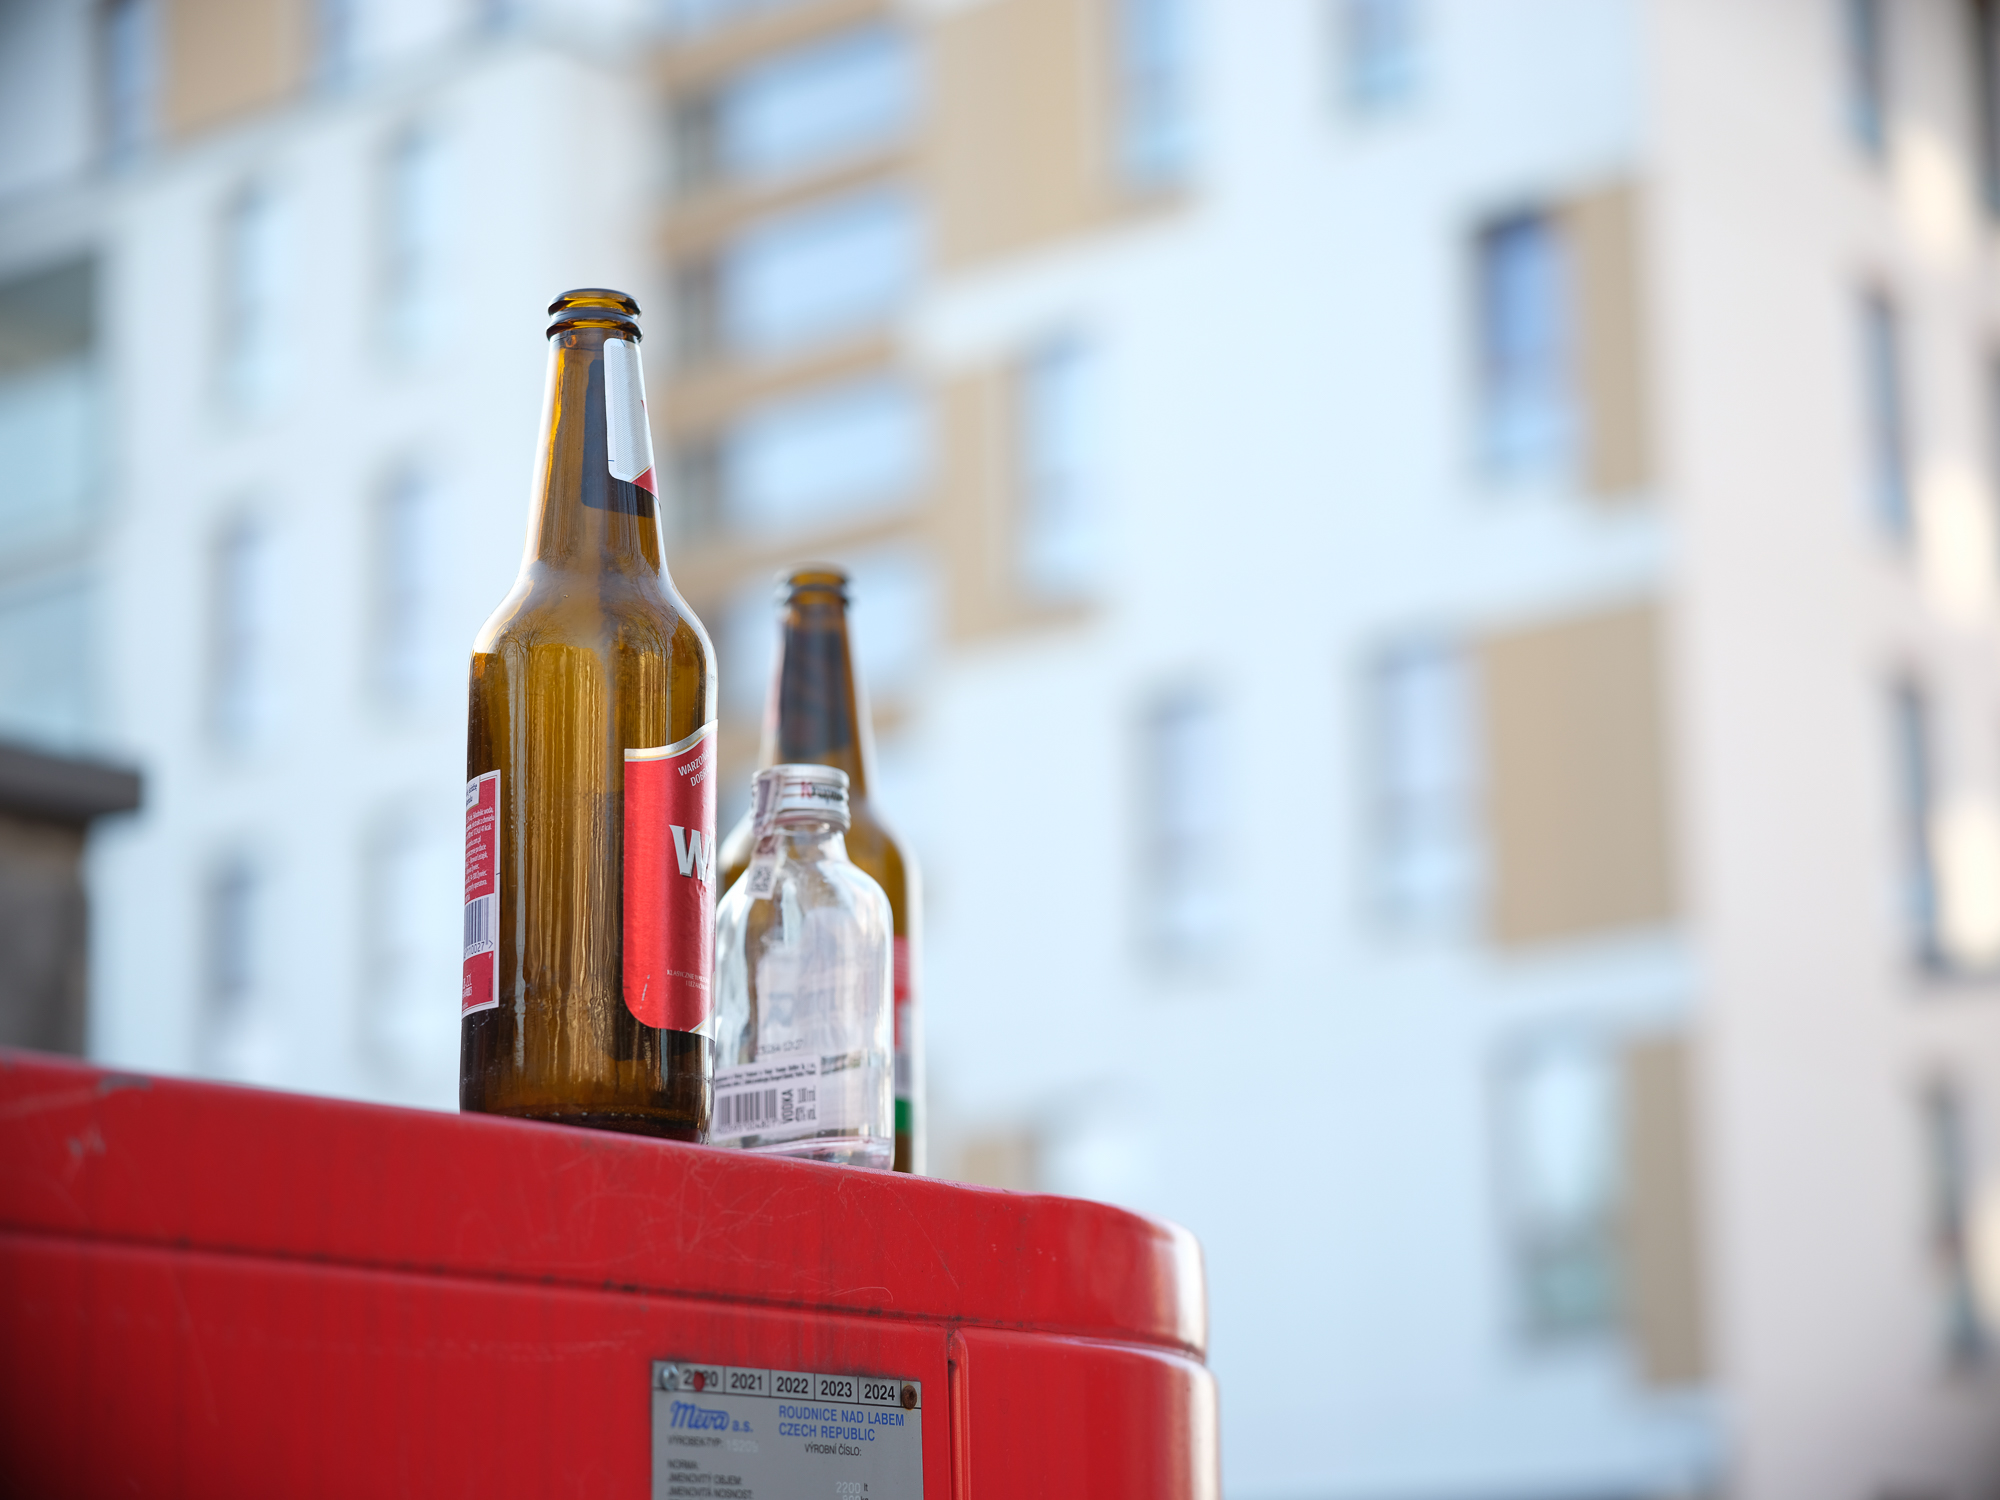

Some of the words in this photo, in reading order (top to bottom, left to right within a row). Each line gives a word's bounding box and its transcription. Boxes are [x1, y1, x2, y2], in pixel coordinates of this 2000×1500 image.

[683, 1368, 719, 1388] 220
[731, 1372, 763, 1391] 2021
[776, 1376, 809, 1394] 2022
[820, 1379, 853, 1398] 2023
[864, 1383, 896, 1401] 2024
[778, 1405, 838, 1422] ROUDNICE
[841, 1409, 864, 1424] NAD
[868, 1411, 905, 1426] LABEM
[778, 1422, 817, 1438] CZECH
[821, 1426, 876, 1442] REPUBLIC
[804, 1441, 837, 1455] VÝROBNÍ
[838, 1443, 862, 1457] ČÍSLO:
[836, 1481, 861, 1494] 2200
